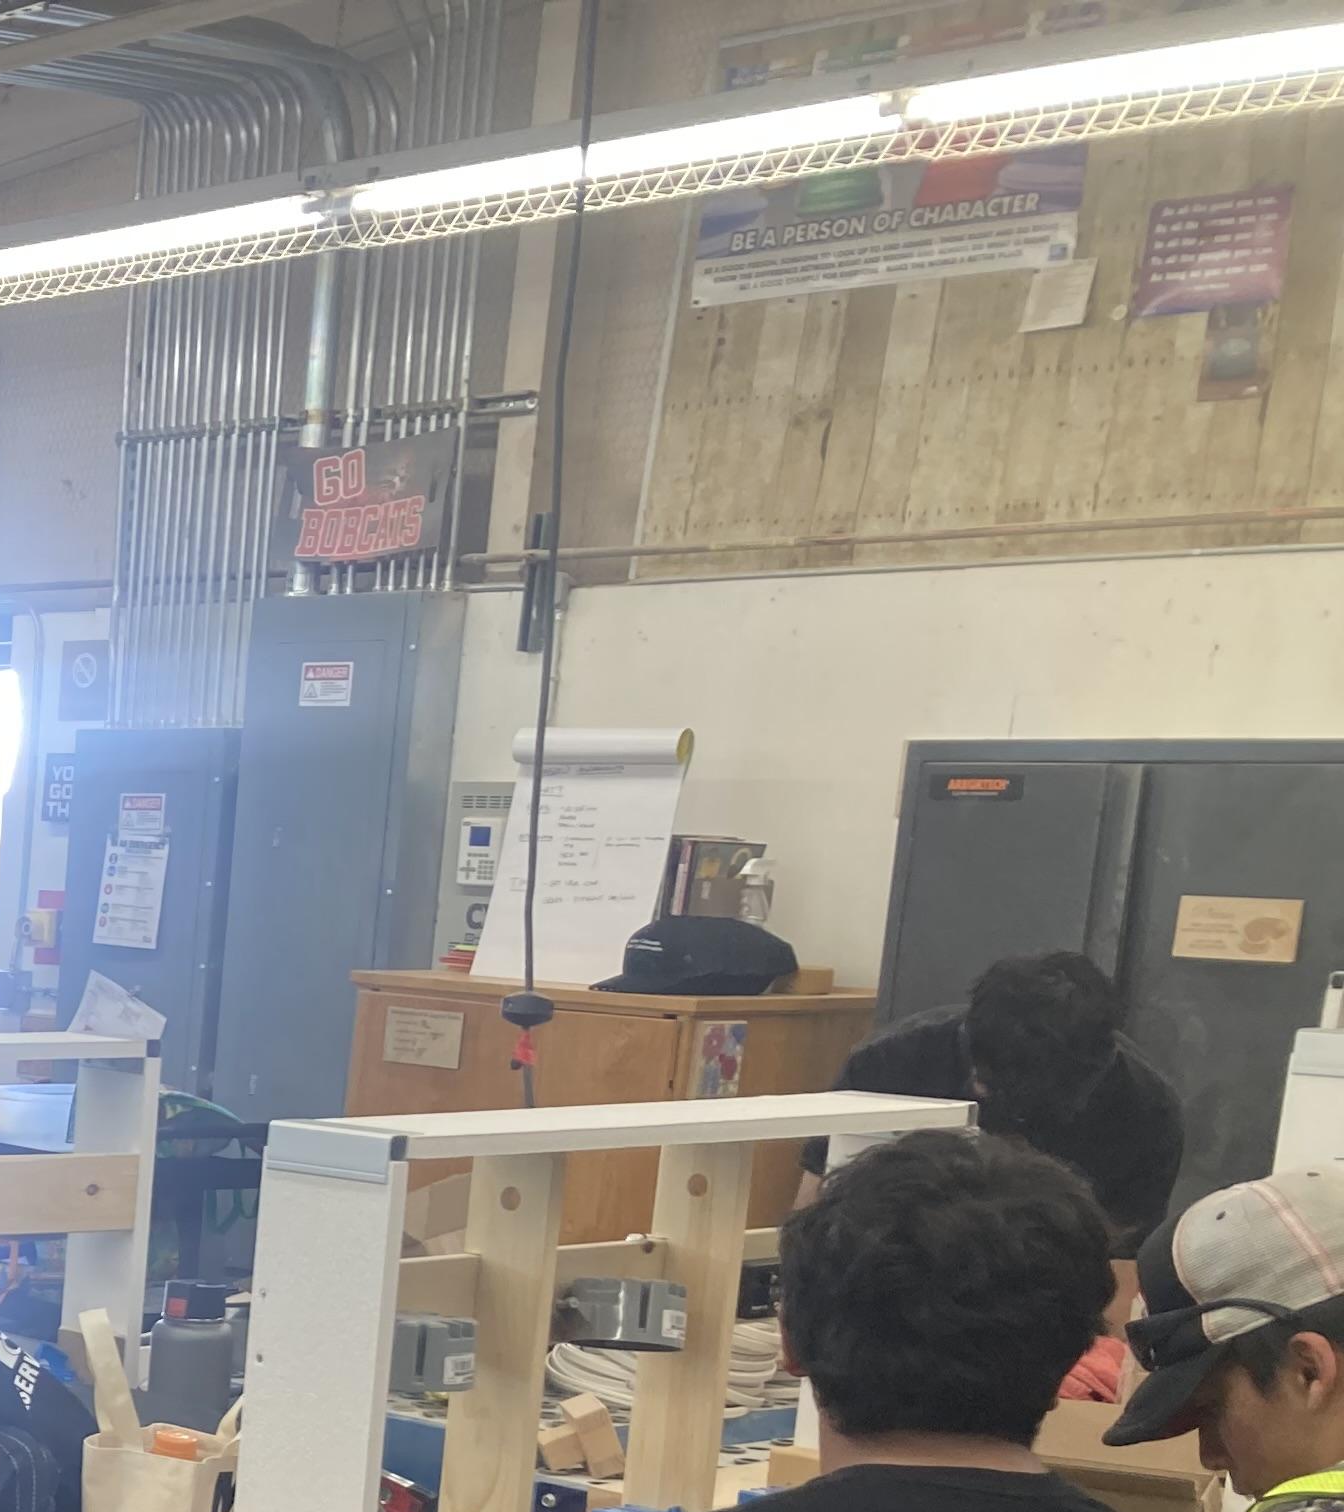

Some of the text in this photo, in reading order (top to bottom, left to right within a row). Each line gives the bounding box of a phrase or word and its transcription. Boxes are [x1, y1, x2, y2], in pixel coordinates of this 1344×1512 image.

[731, 193, 1040, 251] BE A PERSON OF CHARACTER
[313, 448, 365, 506] GO
[293, 494, 425, 563] BOBCATS
